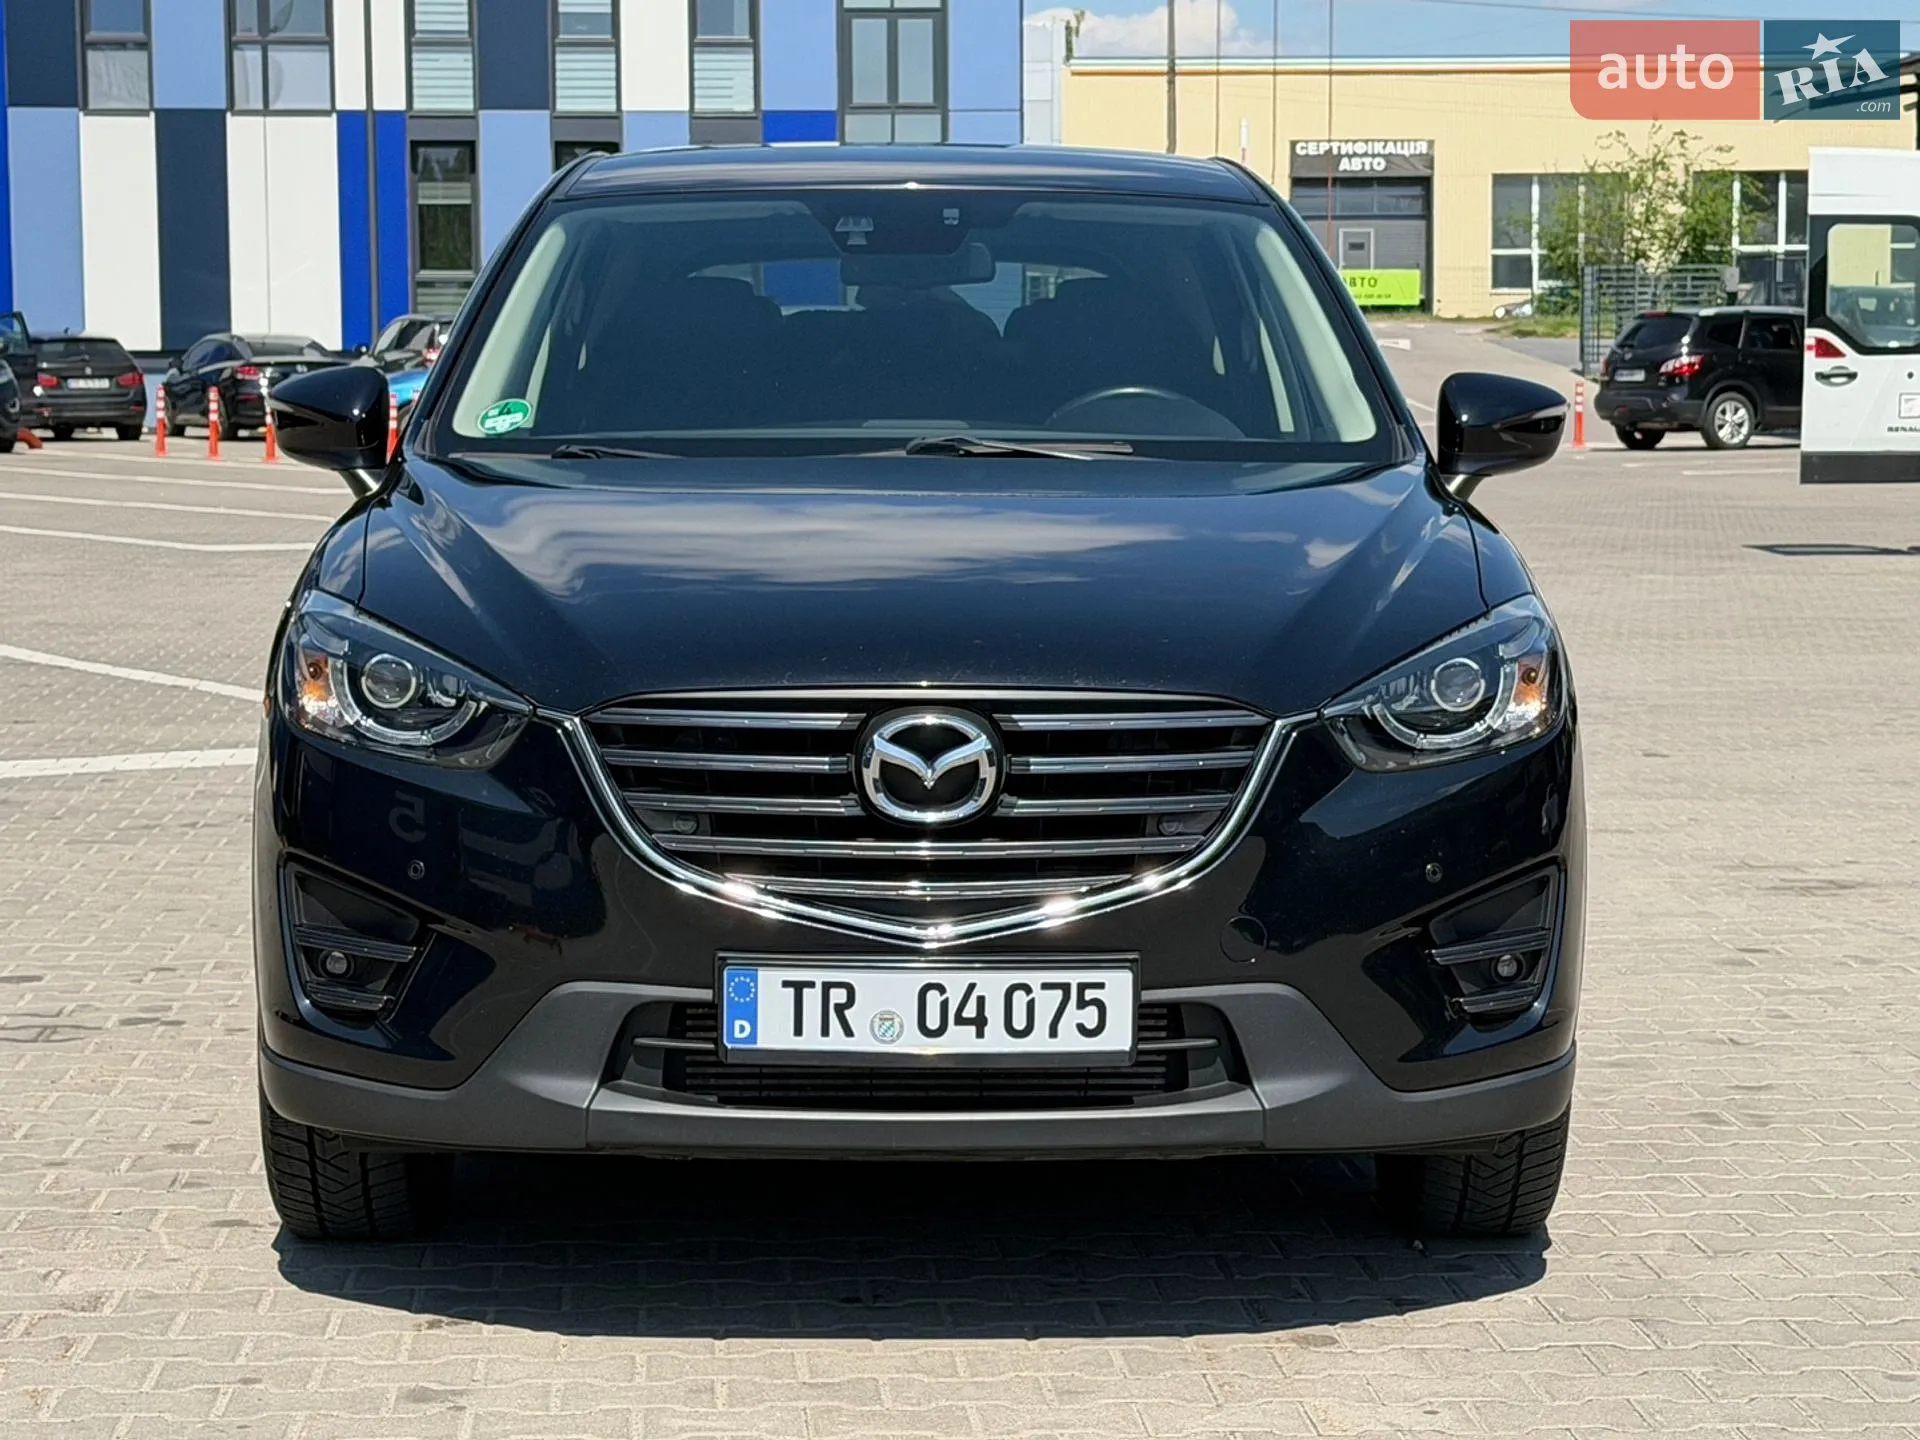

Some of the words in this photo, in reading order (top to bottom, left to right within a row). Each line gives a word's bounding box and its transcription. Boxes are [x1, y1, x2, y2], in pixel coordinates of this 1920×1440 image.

[1295, 140, 1429, 157] СЕРТИФІКАЦІЯ
[1338, 156, 1387, 172] АВТО
[781, 979, 856, 1038] TR
[733, 1019, 751, 1039] D
